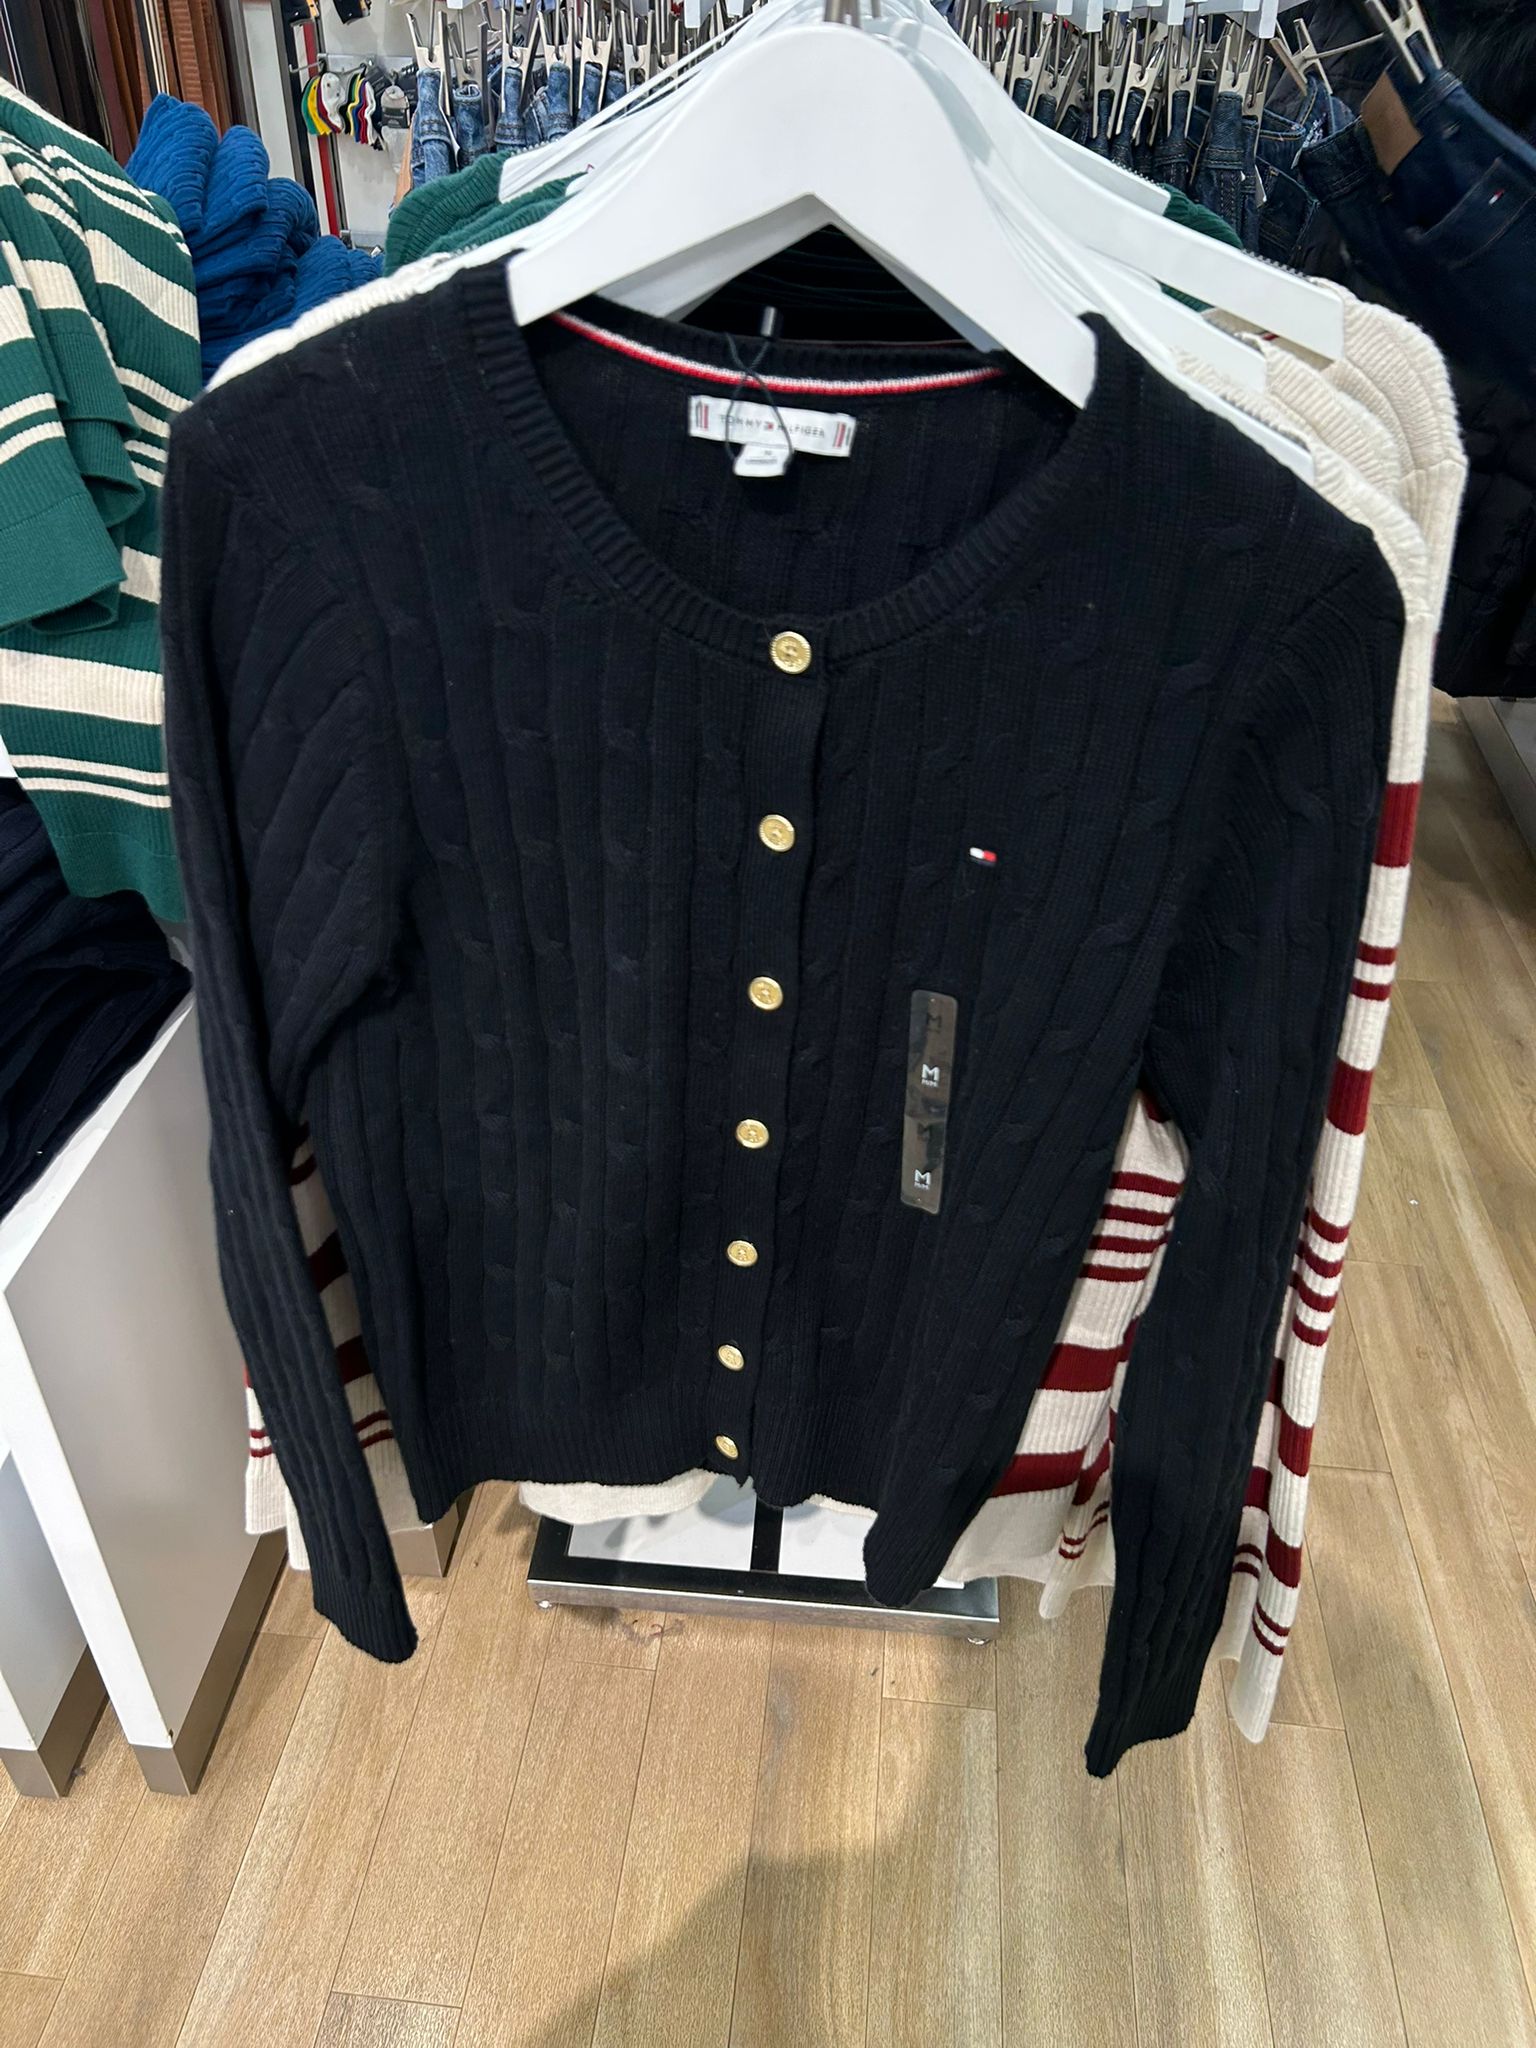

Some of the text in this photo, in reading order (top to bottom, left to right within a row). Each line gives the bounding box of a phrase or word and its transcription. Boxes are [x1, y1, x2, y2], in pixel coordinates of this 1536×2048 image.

[719, 414, 762, 426] TOMMY
[926, 1012, 942, 1028] M
[921, 1064, 940, 1081] M
[914, 1168, 931, 1185] M
